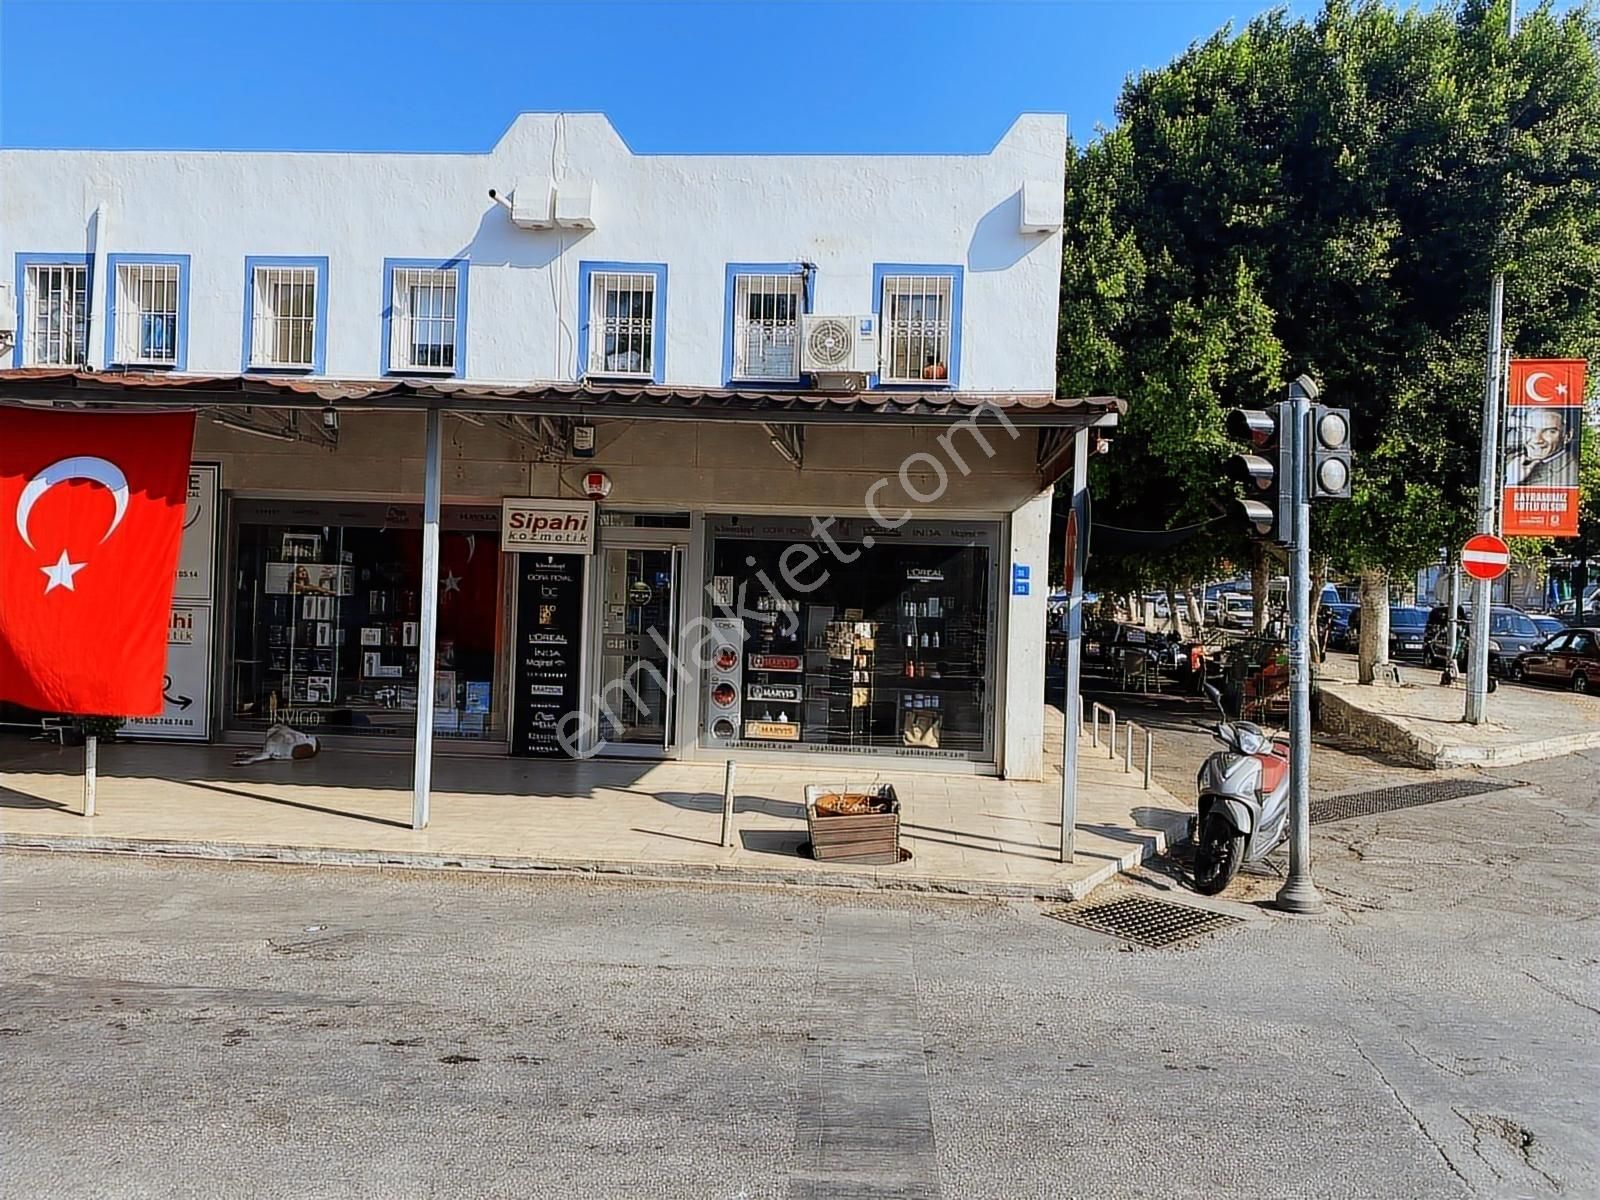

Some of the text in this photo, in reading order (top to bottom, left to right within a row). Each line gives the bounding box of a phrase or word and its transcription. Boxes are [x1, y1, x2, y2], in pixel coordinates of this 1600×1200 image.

[509, 512, 588, 533] Sipahi
[508, 532, 588, 543] kozmetik
[763, 687, 795, 699] MARVIS
[761, 726, 793, 735] MARVIS
